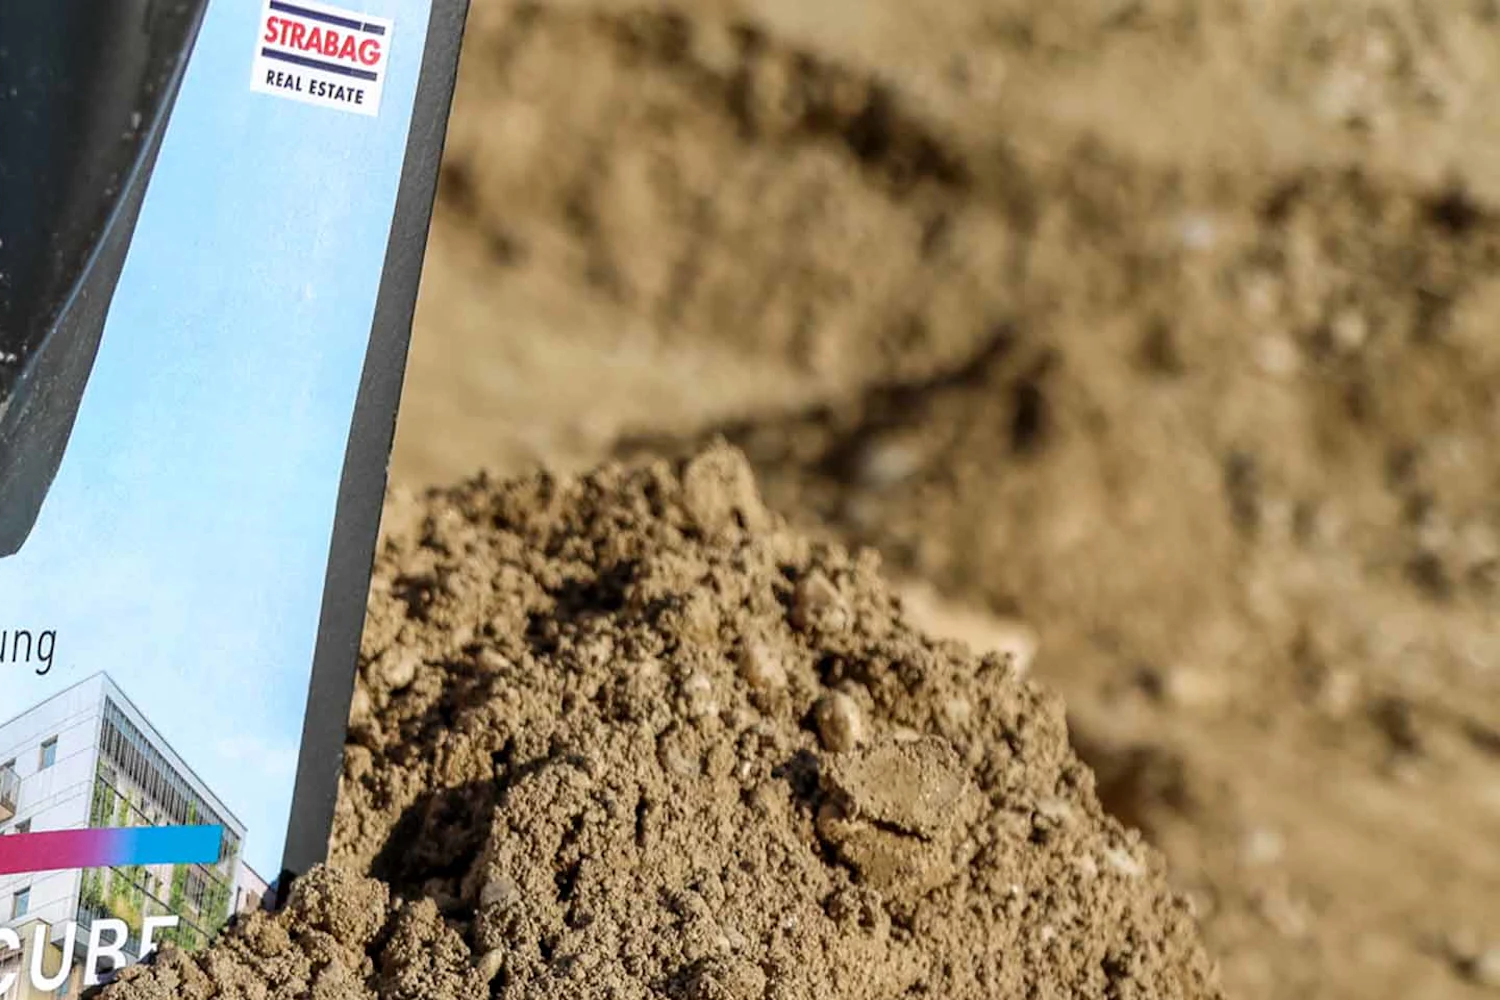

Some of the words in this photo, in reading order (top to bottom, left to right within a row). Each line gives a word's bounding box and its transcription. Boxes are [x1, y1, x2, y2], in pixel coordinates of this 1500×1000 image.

[264, 16, 381, 66] STRABAG
[266, 69, 302, 92] REAL
[308, 79, 364, 105] ESTATE
